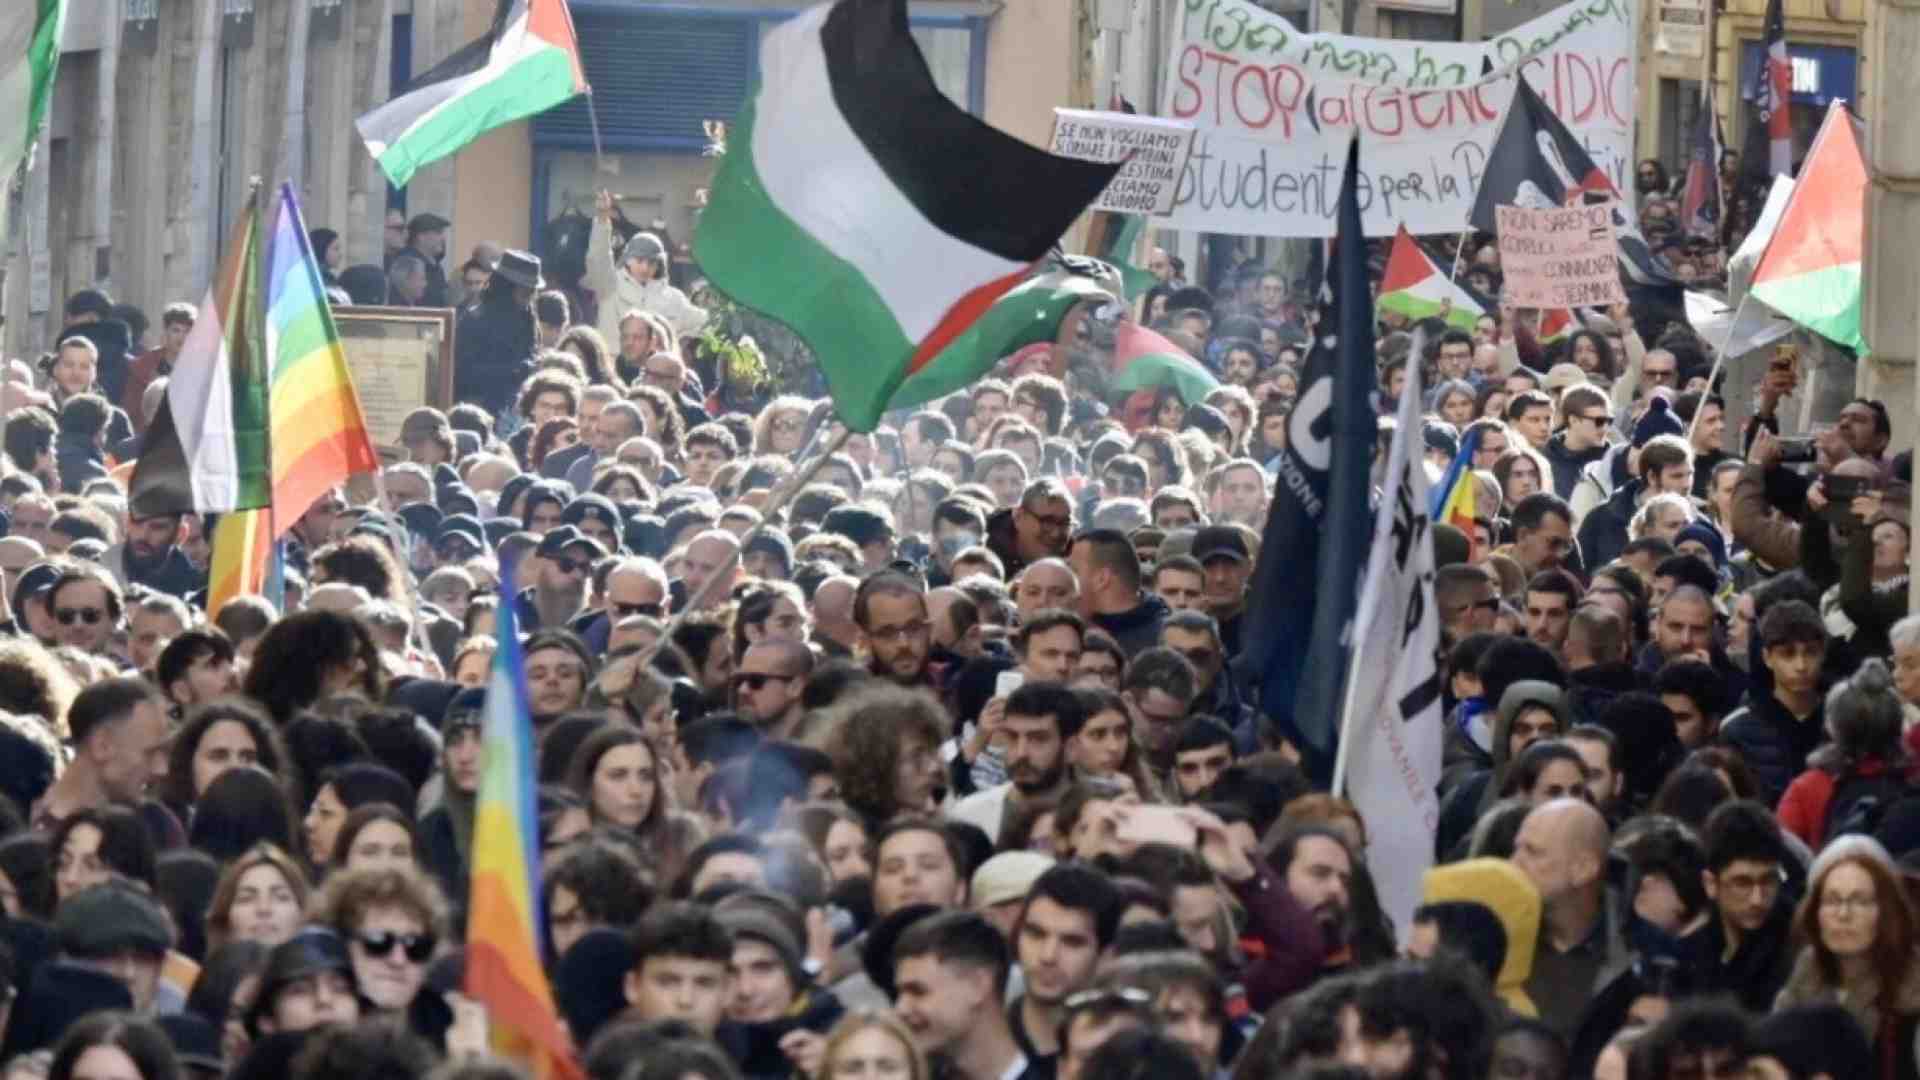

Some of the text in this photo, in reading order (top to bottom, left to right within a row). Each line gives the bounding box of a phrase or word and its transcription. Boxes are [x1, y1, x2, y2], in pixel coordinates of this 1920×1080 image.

[1173, 44, 1305, 138] STOP
[1057, 122, 1181, 149] SE NON VOGLIAMO
